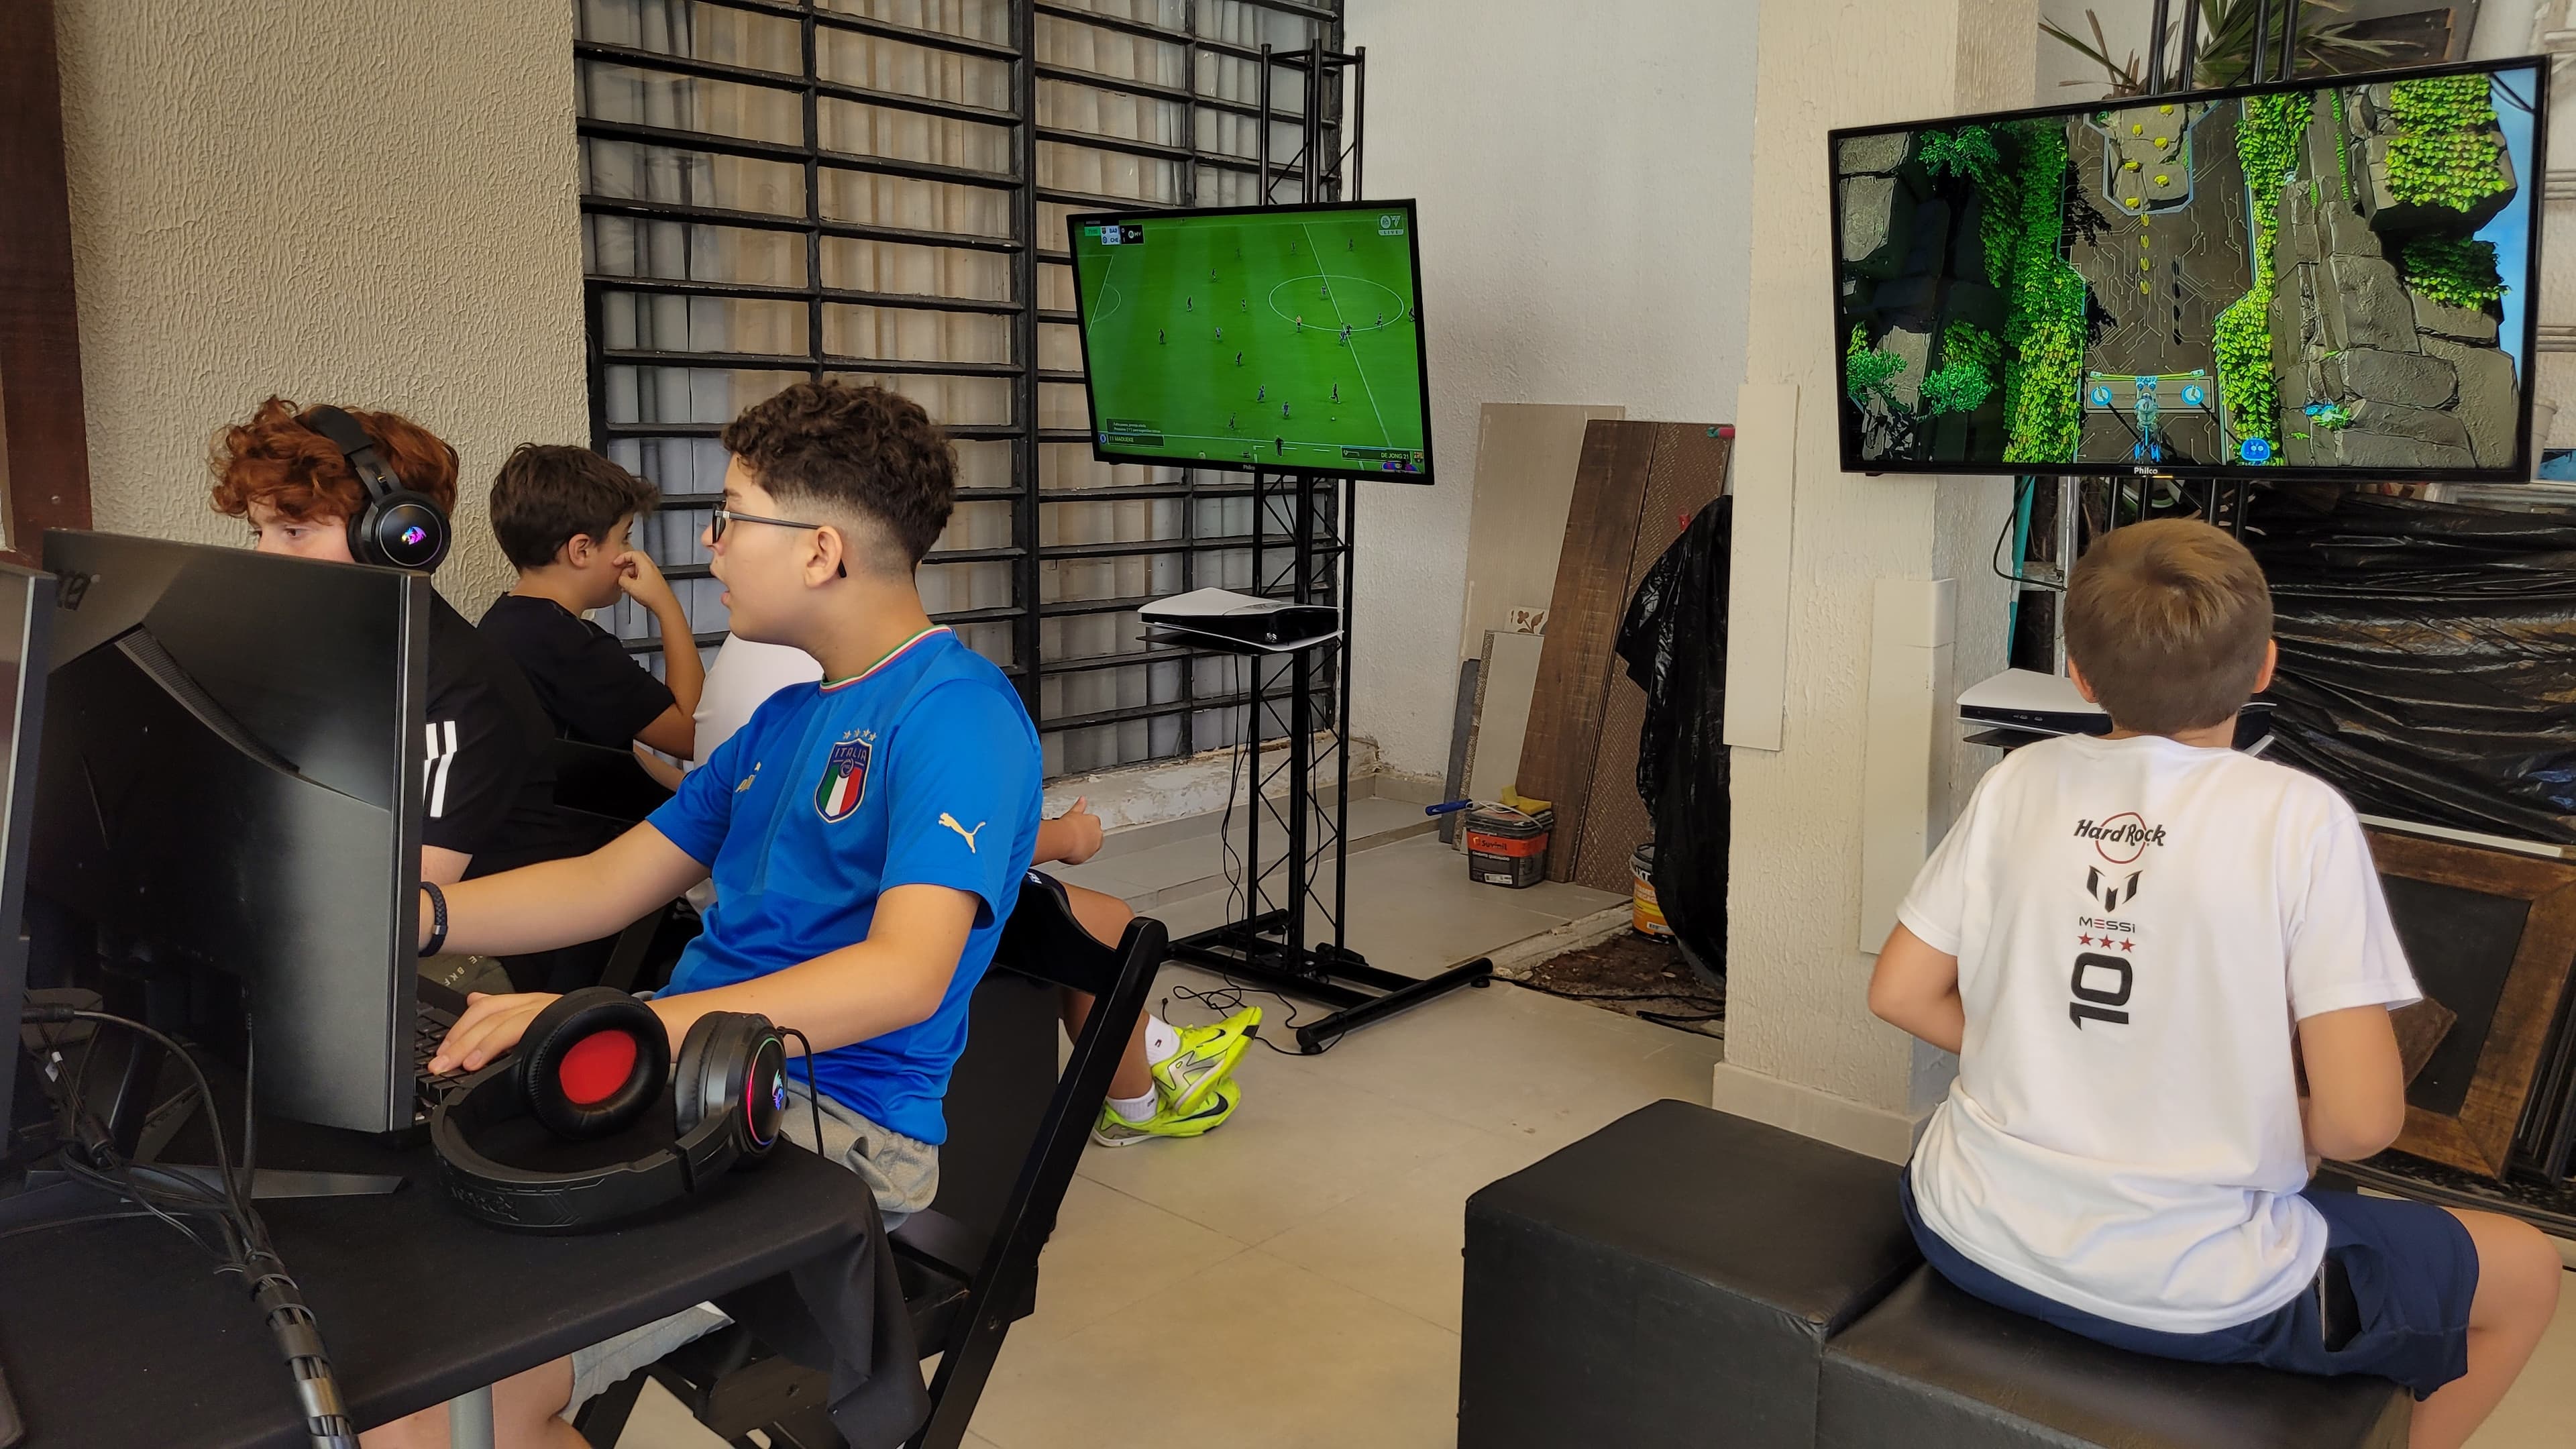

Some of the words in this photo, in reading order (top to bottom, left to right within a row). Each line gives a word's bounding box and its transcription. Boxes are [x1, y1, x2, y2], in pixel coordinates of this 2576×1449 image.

[2133, 466, 2158, 475] Philco
[835, 747, 867, 761] ITALIA
[2074, 819, 2127, 843] Hard
[2125, 824, 2166, 847] Rock
[1481, 839, 1507, 851] Suvinil
[2070, 951, 2133, 1031] 10
